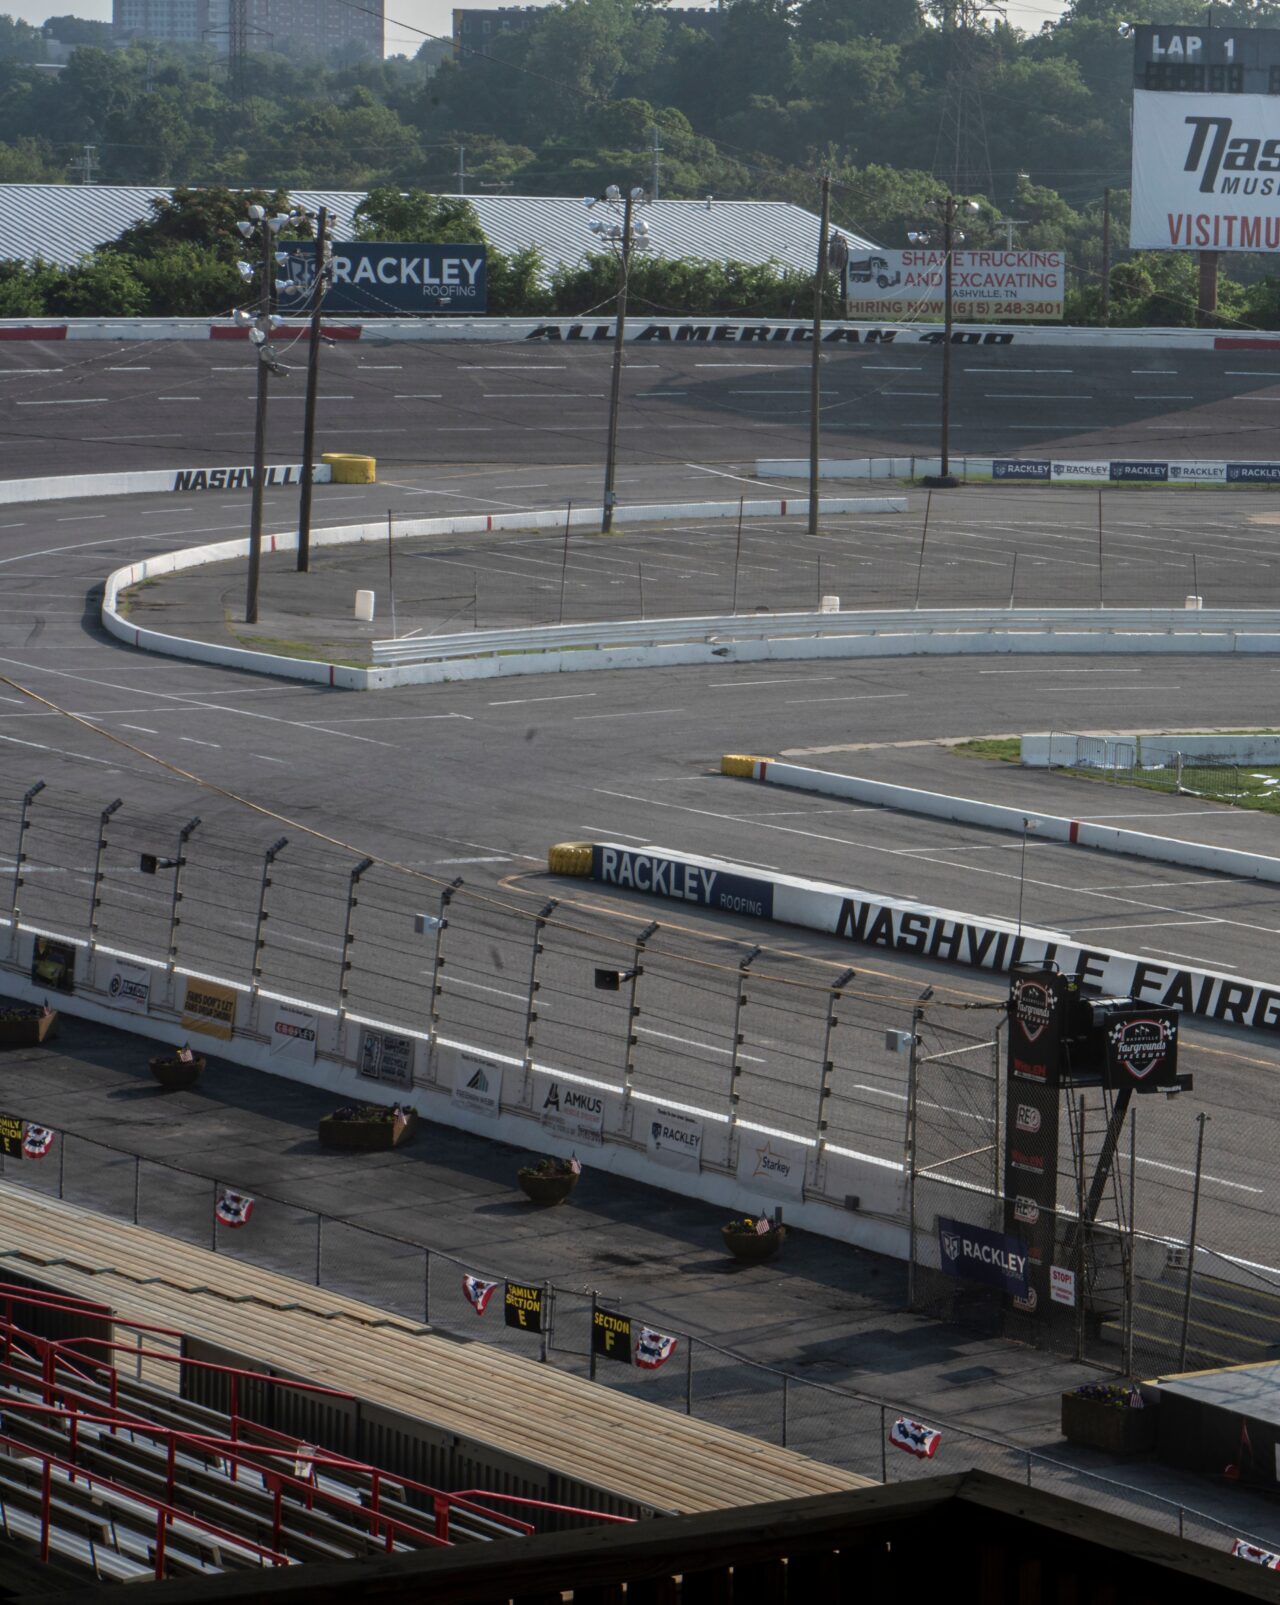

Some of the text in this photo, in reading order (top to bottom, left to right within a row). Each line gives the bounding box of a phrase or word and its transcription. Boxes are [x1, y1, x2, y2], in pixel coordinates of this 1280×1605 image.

[1152, 35, 1202, 55] LAP
[1224, 38, 1234, 57] 1
[902, 250, 1060, 268] SHANE TRUCKING
[332, 256, 483, 286] RACKLEY
[904, 272, 1057, 288] AND EXCAVATING
[423, 284, 476, 297] ROOFING
[948, 289, 1017, 299] ASHVILLE, TN
[849, 301, 1061, 316] HIRING NOW (615) 248-3401
[524, 325, 1014, 345] ALL AMERICAN 400
[1008, 464, 1049, 474] RACKLEY
[1066, 465, 1107, 474] RACKLEY
[1124, 466, 1166, 475] RACKLEY
[1183, 467, 1224, 476] RACKLEY
[602, 848, 763, 918] RACKLEY ROOFING
[835, 898, 1110, 997] NASHVILLE
[1118, 1040, 1166, 1055] Fairgrounds
[1117, 1052, 1166, 1060] SPEEDWAY
[564, 1090, 602, 1113] AMKUS
[0, 1118, 20, 1130] MILY
[0, 1127, 22, 1140] CTION
[662, 1126, 700, 1148] RACKLEY
[4, 1137, 11, 1152] E
[762, 1155, 791, 1177] Starkey
[962, 1239, 1026, 1273] RACKLEY
[1053, 1270, 1072, 1285] STOP!
[508, 1284, 538, 1300] FAMILY
[506, 1295, 540, 1313] SECTION
[518, 1310, 527, 1326] E
[594, 1311, 630, 1335] SECTION
[605, 1331, 615, 1350] F
